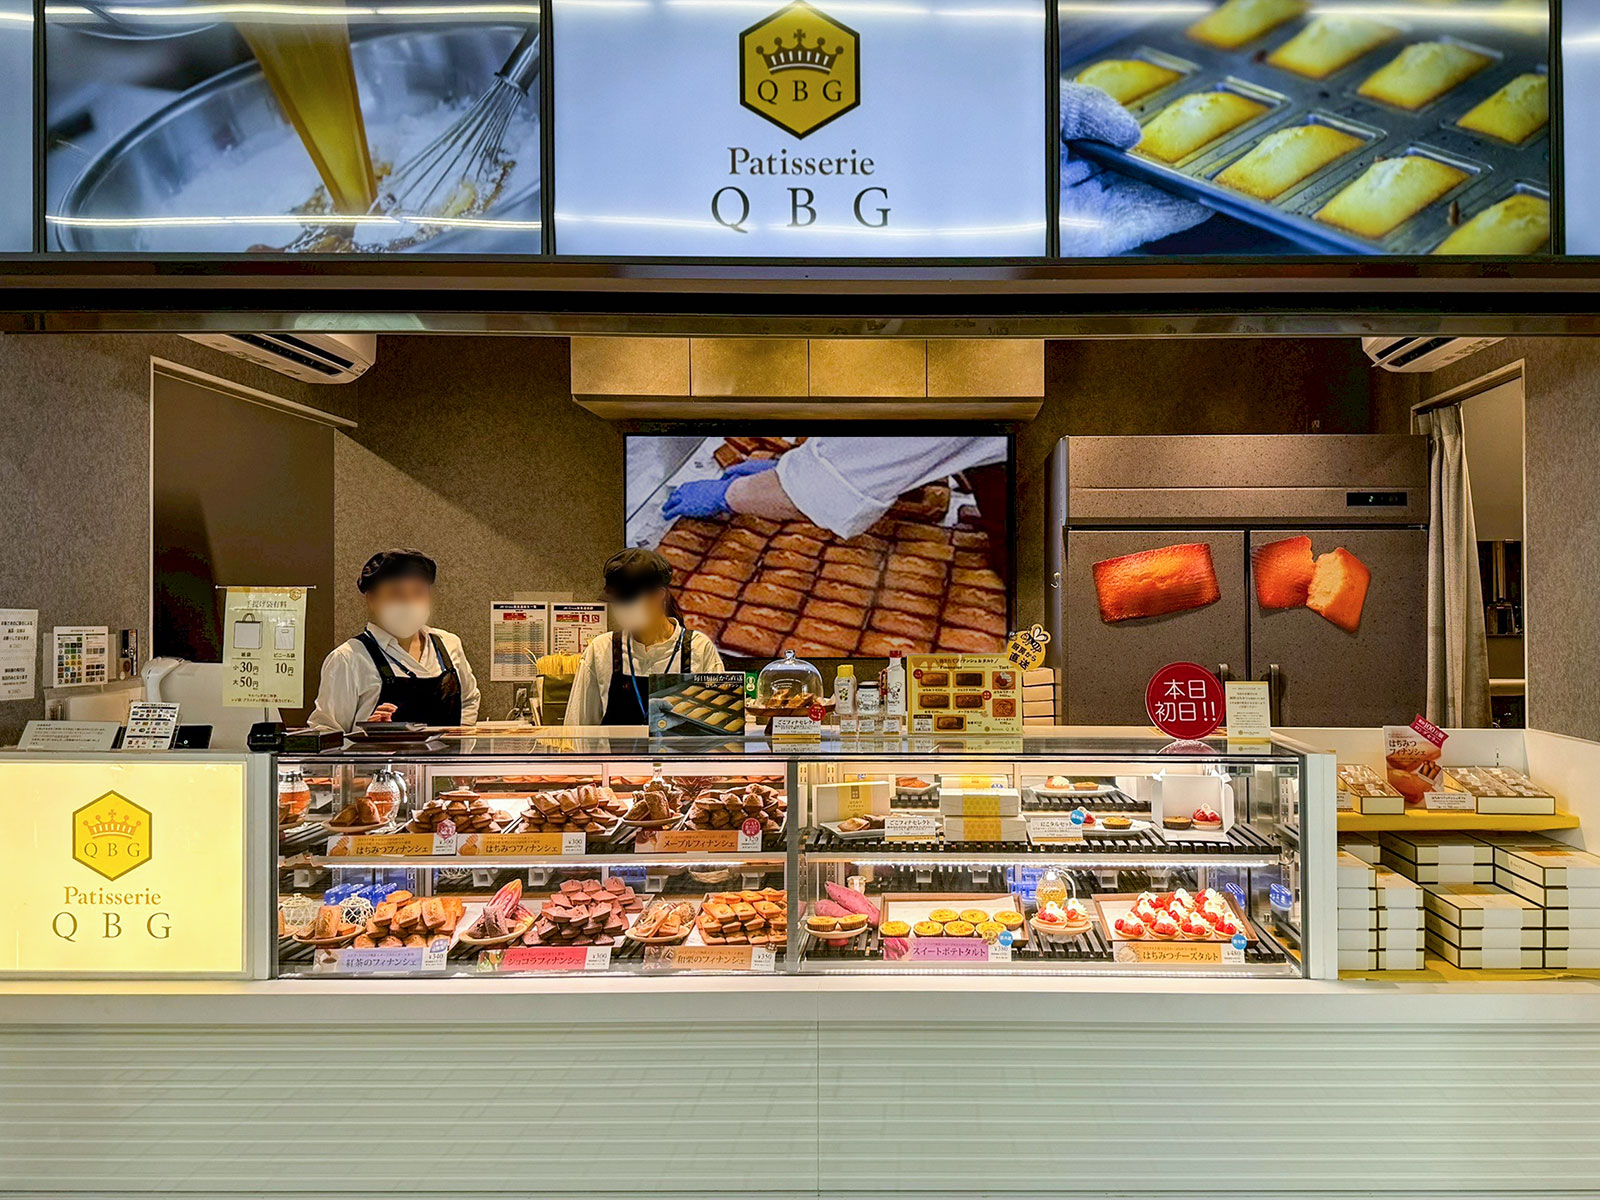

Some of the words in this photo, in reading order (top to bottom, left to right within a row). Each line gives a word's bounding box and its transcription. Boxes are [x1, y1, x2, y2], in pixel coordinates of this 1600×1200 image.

[727, 147, 875, 176] Patisserie
[1011, 642, 1037, 662] 厨房から
[1008, 652, 1031, 671] 直送
[1163, 679, 1207, 700] 本日
[1388, 739, 1417, 748] はちみつ
[1389, 748, 1426, 757] フィナンシェ
[356, 845, 429, 855] はちみつフィナンシェ
[485, 844, 558, 853] はちみつフィナンシェ
[663, 840, 735, 849] メープルフィナンシェ
[63, 886, 162, 906] Patisserie
[913, 946, 986, 958] スイートポテトタルト
[1142, 950, 1218, 961] はちみつチーズタルト
[346, 957, 417, 968] 紅茶のフィナンシェ
[508, 956, 582, 967] ショコラフィナンシェ
[677, 955, 745, 965] 和栗のフィナンシェ
